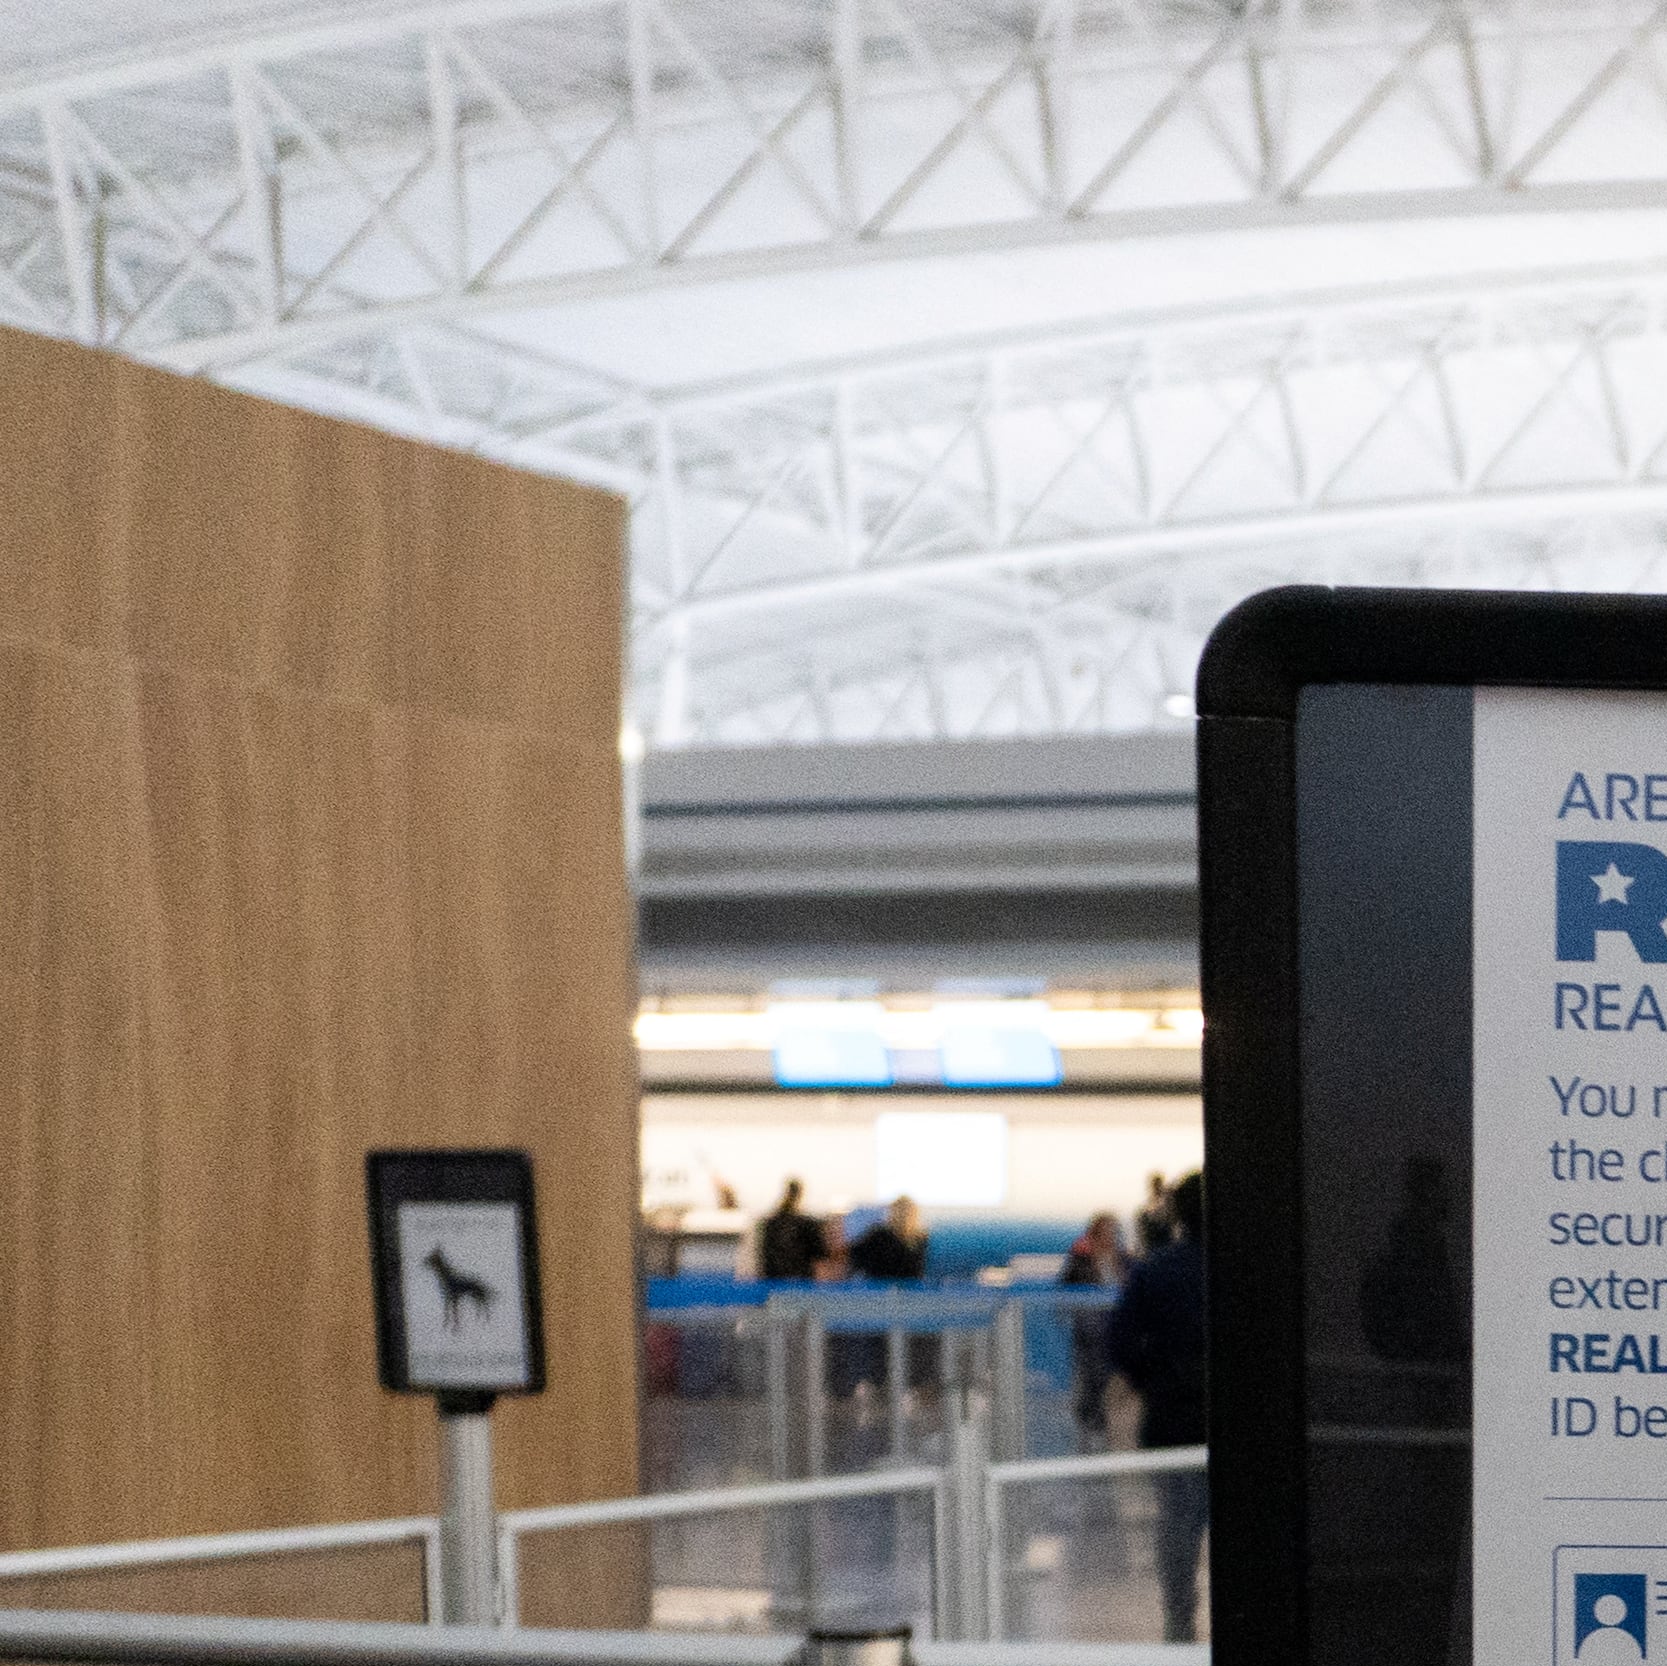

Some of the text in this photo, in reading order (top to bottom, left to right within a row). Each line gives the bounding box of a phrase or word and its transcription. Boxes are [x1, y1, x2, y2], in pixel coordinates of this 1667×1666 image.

[1548, 1075, 1637, 1119] You
[1548, 1139, 1625, 1183] the
[1551, 1396, 1598, 1438] ID
